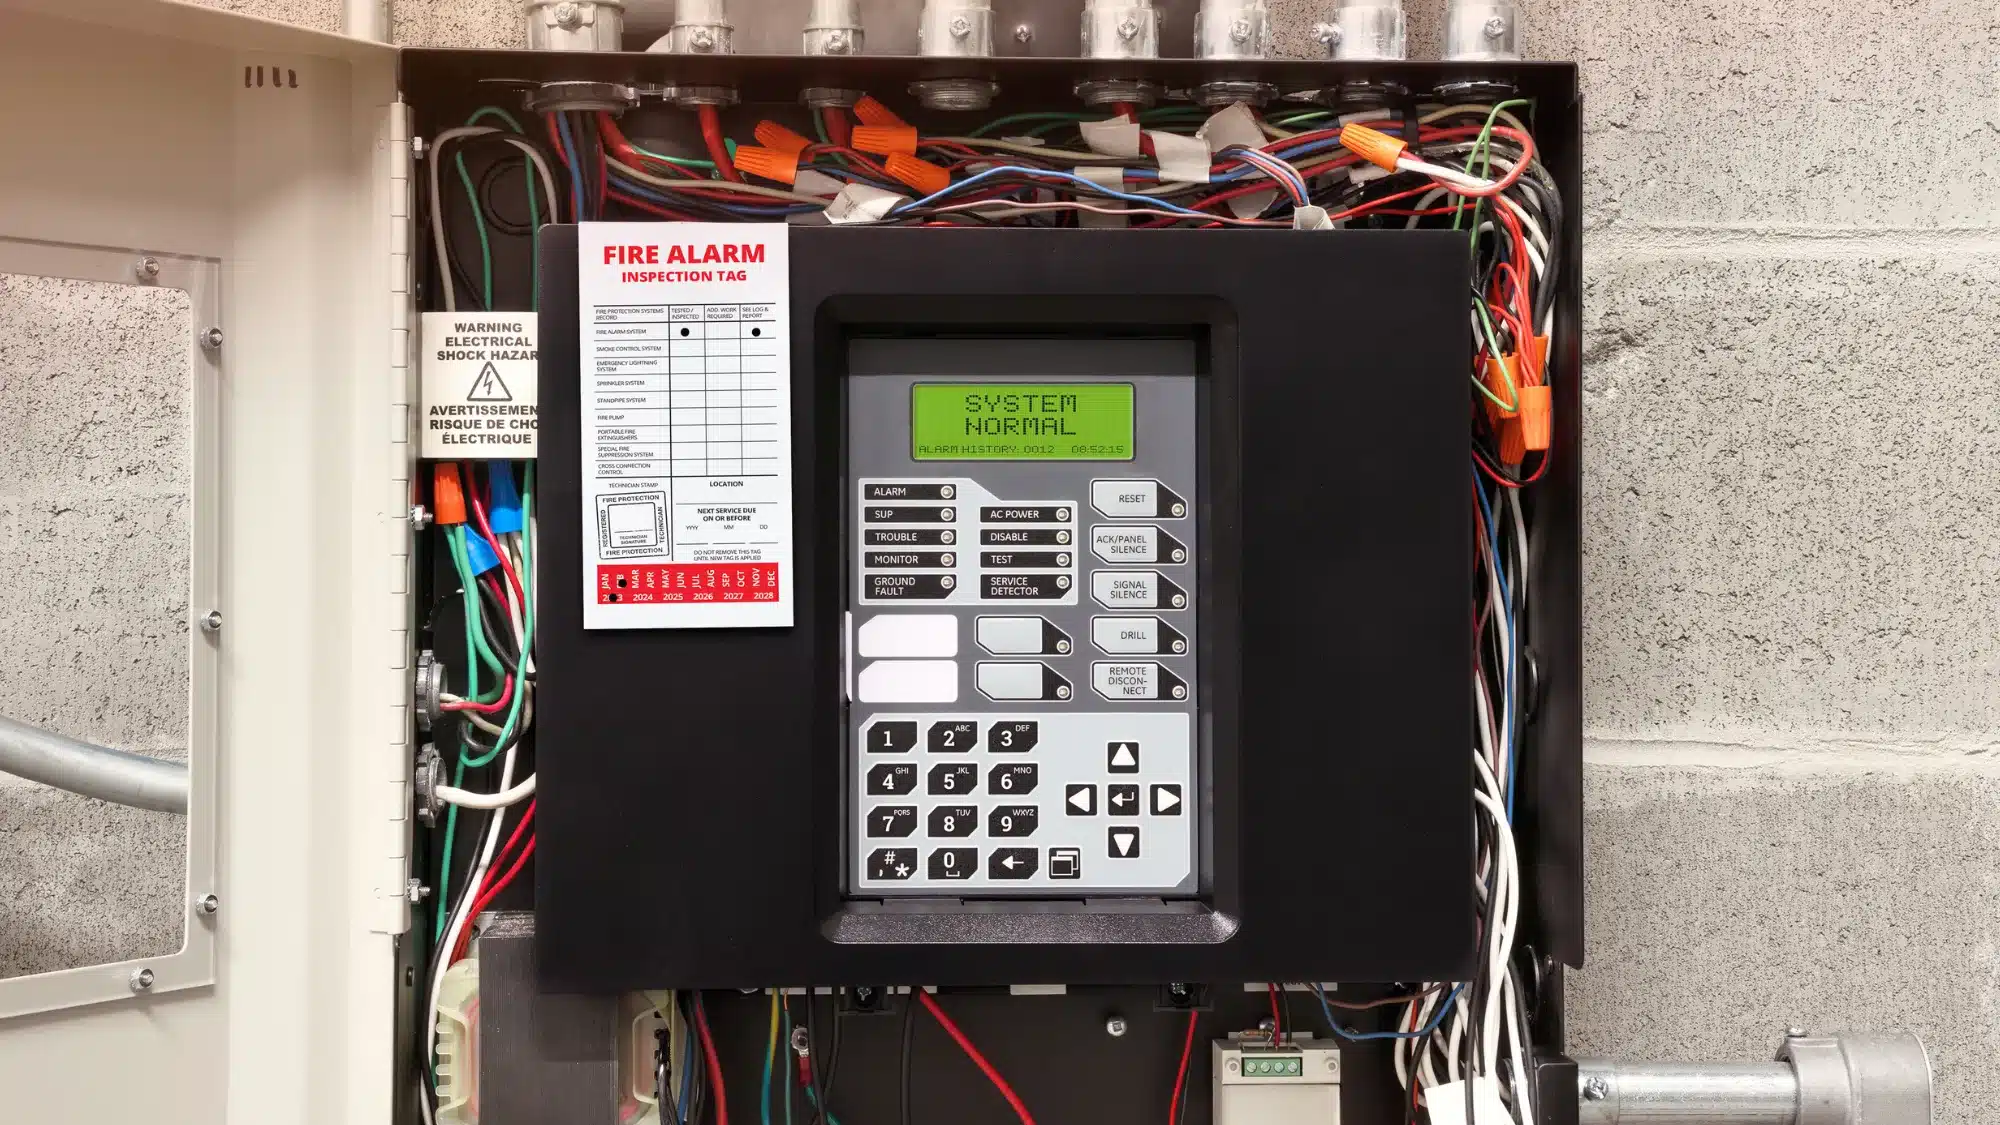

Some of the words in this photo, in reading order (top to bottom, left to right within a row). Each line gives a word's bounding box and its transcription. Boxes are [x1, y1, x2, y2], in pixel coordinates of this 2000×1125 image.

[604, 246, 658, 264] FIRE
[667, 244, 765, 264] ALARM
[622, 271, 712, 283] INSPECTION
[717, 270, 747, 281] TAG
[455, 323, 522, 332] WARNING
[445, 337, 532, 346] ELECTRICAL
[437, 351, 486, 360] SHOCK
[965, 395, 1077, 413] SYSTEM
[430, 419, 482, 429] RISQUE
[487, 420, 505, 429] DE
[965, 417, 1077, 435] NORMAL
[442, 432, 531, 444] ÉLECTRIQUE
[918, 445, 959, 454] ALARM
[1024, 445, 1055, 454] 0012
[1071, 445, 1124, 454] 08:52:15
[874, 488, 906, 496] ALARM
[1119, 494, 1146, 503] RESET
[875, 510, 893, 519] SUP
[990, 510, 1003, 519] AC
[1005, 510, 1039, 519] POWER
[875, 532, 917, 541] TROUBLE
[991, 533, 1028, 541] DISABLE
[1096, 535, 1147, 544] ACK/PANEL
[622, 547, 663, 555] PROTECTION
[1110, 545, 1147, 554] SILENCE
[875, 555, 918, 564] MONITOR
[991, 556, 1012, 564] TEST
[601, 574, 611, 590] JAN
[677, 572, 686, 588] JUN
[692, 574, 701, 588] JUL
[707, 570, 715, 587] AUG
[722, 573, 730, 587] SEP
[737, 571, 745, 587] OCT
[752, 568, 760, 586] NOV
[874, 578, 915, 586] GROUND
[990, 577, 1028, 586] SERVICE
[1114, 580, 1147, 589] SIGNAL
[875, 587, 904, 596] FAULT
[991, 587, 1039, 596] DETECTOR
[1110, 590, 1147, 599] SILENCE
[1120, 631, 1146, 640] DRILL
[1109, 667, 1146, 676] REMOTE
[1108, 677, 1147, 686] DISCON-
[1123, 686, 1146, 695] NECT
[883, 731, 893, 746] 1
[944, 730, 955, 746] 2
[1001, 730, 1012, 746] 3
[956, 767, 969, 775] JKL
[882, 774, 894, 790] 4
[944, 774, 955, 789] 5
[1001, 773, 1012, 789] 6
[893, 809, 910, 817] PQRS
[882, 816, 894, 831] 7
[943, 816, 955, 832] 8
[1001, 816, 1012, 831] 9
[884, 851, 896, 864] #
[944, 852, 955, 868] 0
